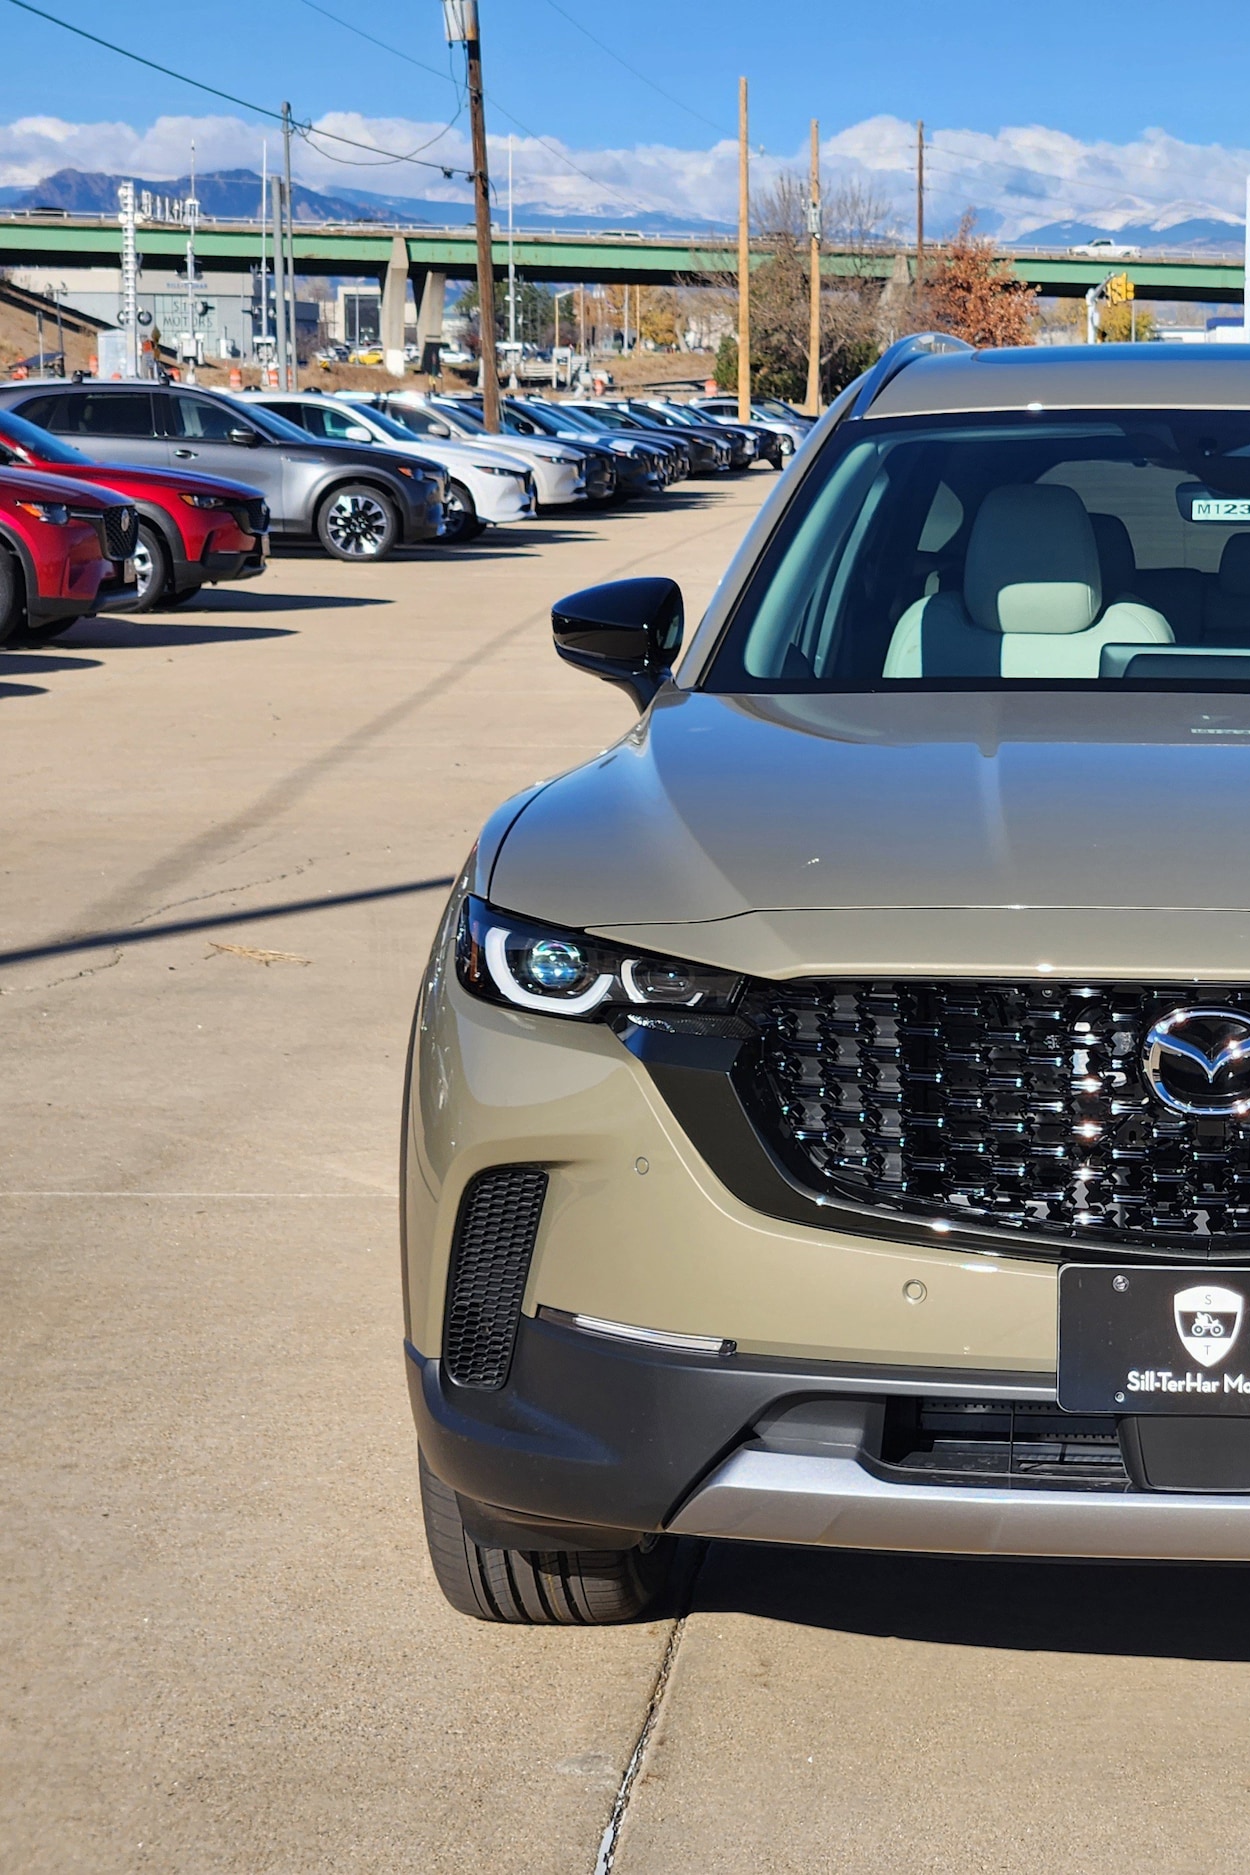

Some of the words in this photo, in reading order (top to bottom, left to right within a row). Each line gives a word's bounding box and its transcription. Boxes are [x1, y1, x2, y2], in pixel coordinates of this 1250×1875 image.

[1204, 1294, 1212, 1305] S
[1204, 1345, 1211, 1355] T
[1126, 1370, 1221, 1393] Sill-TerHar
